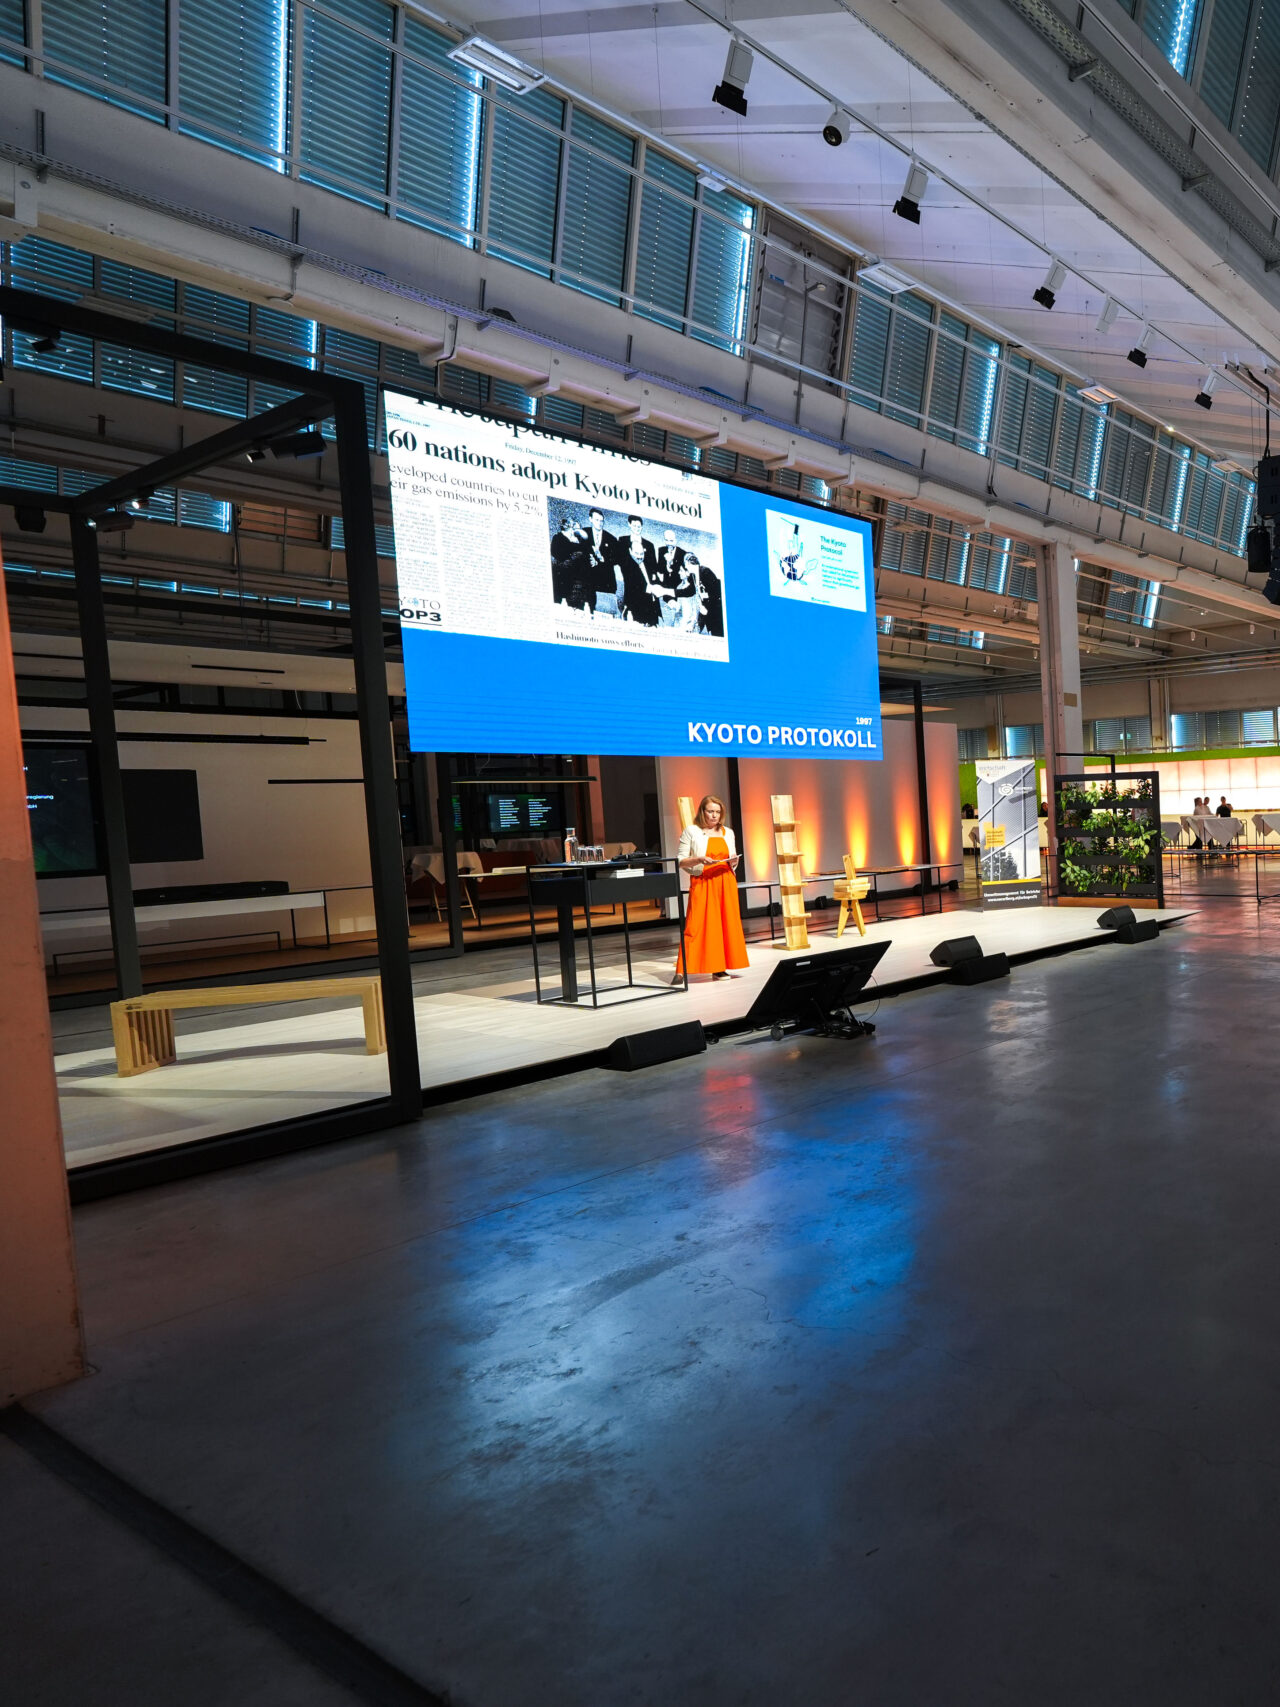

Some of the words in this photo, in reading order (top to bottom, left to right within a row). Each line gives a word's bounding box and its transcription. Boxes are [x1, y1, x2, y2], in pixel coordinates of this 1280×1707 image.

[525, 447, 553, 460] December
[424, 441, 506, 473] nations
[511, 462, 568, 489] adopt
[574, 472, 630, 501] Kyoto
[634, 488, 703, 519] Protocol
[450, 477, 505, 495] countries
[508, 488, 520, 499] to
[522, 493, 539, 503] cut
[411, 485, 432, 496] gas
[435, 489, 494, 508] emissions
[496, 498, 511, 513] by
[513, 502, 543, 517] 5.2%
[820, 535, 830, 545] The
[830, 537, 847, 548] Kyoto
[820, 545, 843, 556] Protocol
[556, 631, 600, 644] Hashimoto
[855, 717, 873, 726] 1997
[687, 722, 762, 745] KYOTO
[767, 726, 877, 748] PROTOKOLL
